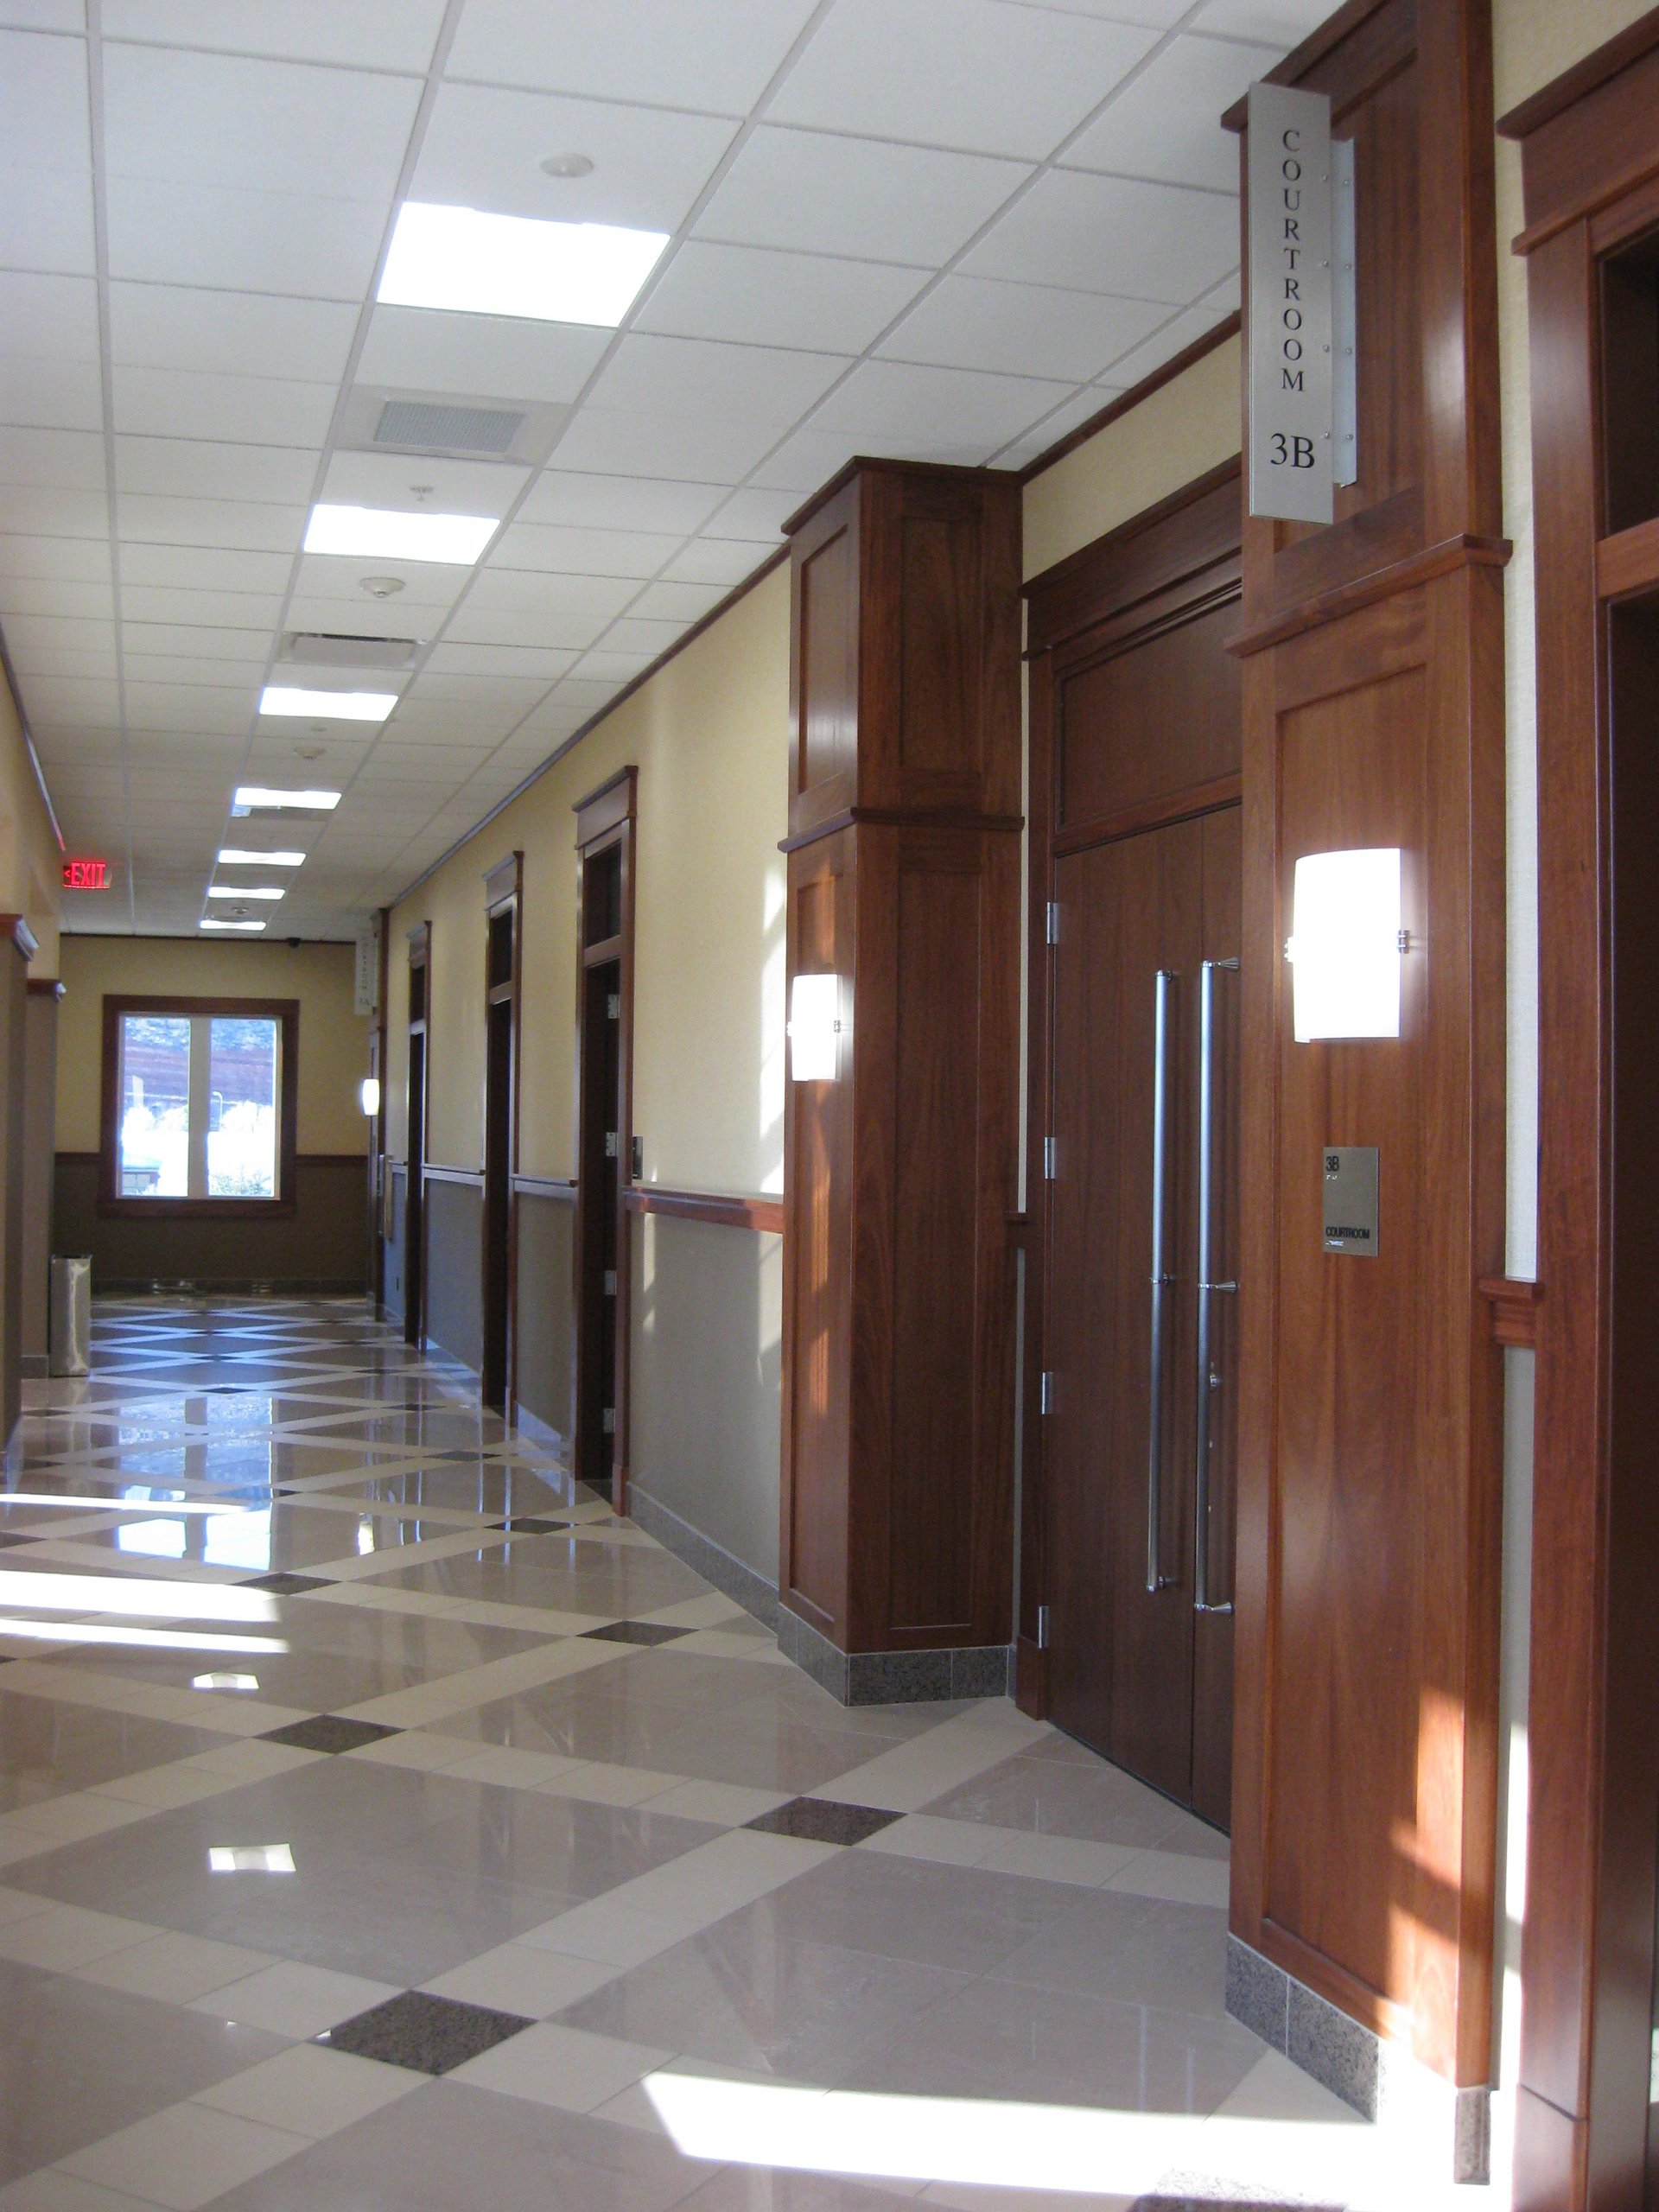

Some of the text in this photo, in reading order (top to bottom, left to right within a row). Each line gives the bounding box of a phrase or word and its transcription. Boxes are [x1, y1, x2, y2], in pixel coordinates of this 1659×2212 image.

[1281, 130, 1304, 391] COURTROOM
[1270, 433, 1315, 469] 3B
[71, 862, 106, 887] EXIT
[1325, 1155, 1339, 1172] 3B
[1325, 1226, 1370, 1239] COURTROOM
